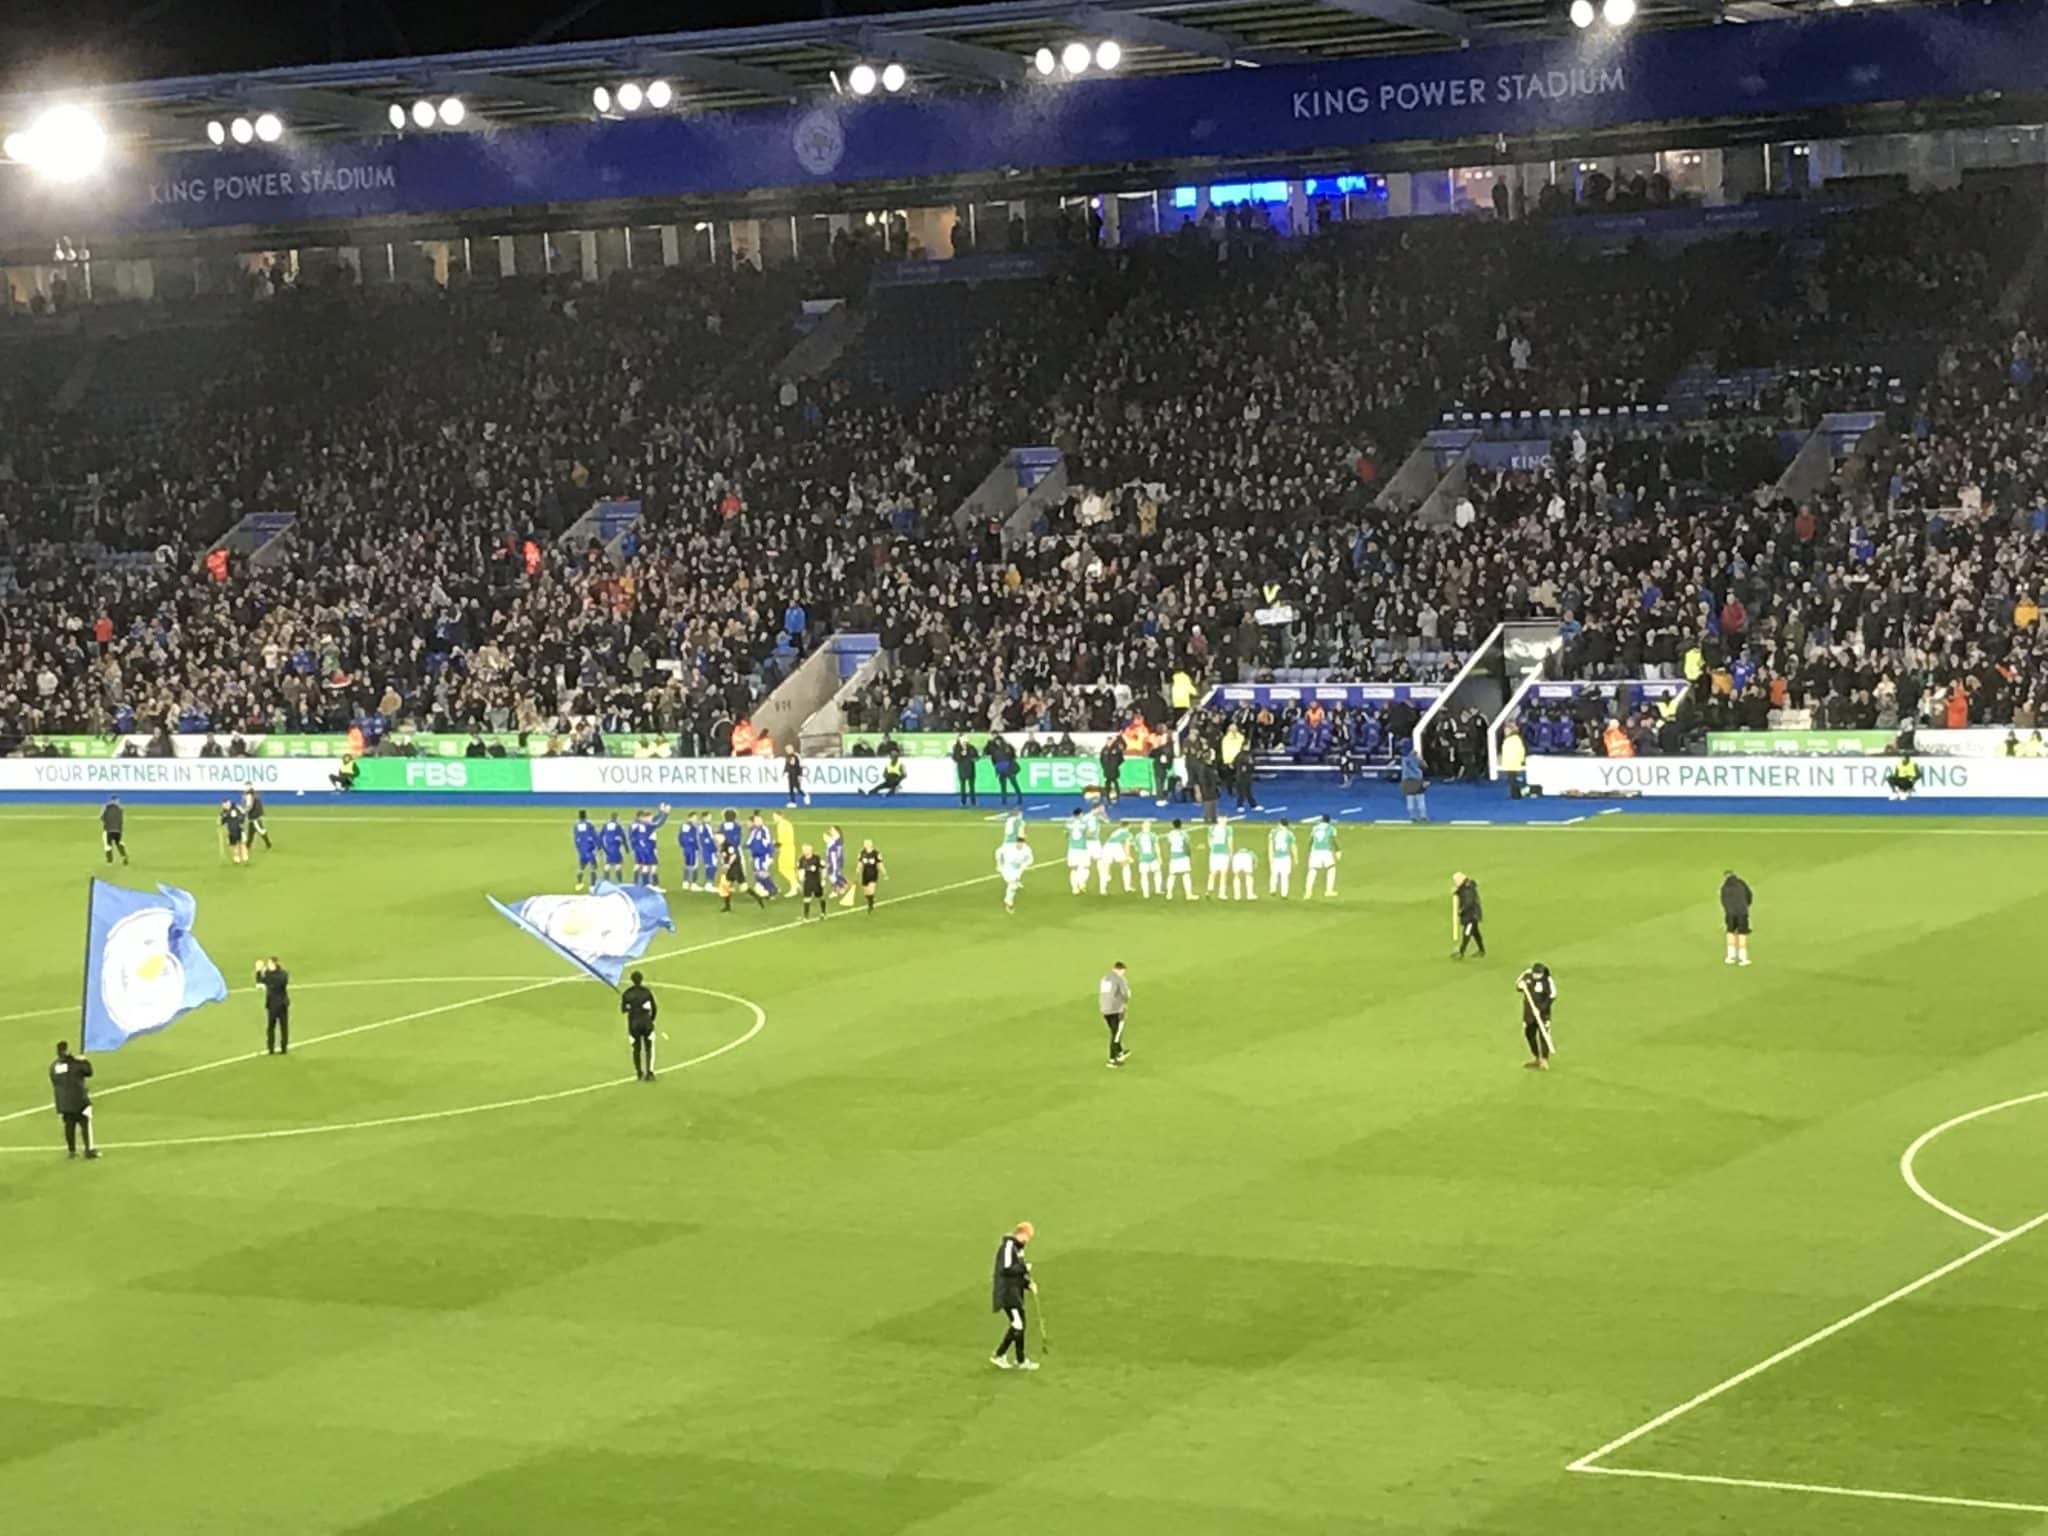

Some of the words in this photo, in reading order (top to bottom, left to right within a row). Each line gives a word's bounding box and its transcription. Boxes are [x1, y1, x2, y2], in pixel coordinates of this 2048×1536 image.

[1293, 86, 1369, 119] KING
[1380, 78, 1486, 111] POWER
[1497, 67, 1626, 102] STADIUM
[150, 178, 207, 205] KING
[213, 171, 294, 200] POWER
[299, 165, 396, 194] STADIUM
[34, 764, 83, 782] YOUR
[88, 764, 168, 782] PARTNER
[174, 764, 191, 782] IN
[196, 764, 279, 782] TRADING
[405, 761, 467, 788] FBS
[599, 764, 653, 785] YOUR
[659, 764, 752, 785] PARTNER
[758, 765, 778, 785] IN
[782, 765, 880, 785] RADING
[1028, 761, 1100, 789] FBS
[1600, 764, 1670, 787] YOUR
[1680, 764, 1801, 787] PARTNER
[1808, 765, 1834, 787] IN
[1844, 764, 1968, 788] TRAING
